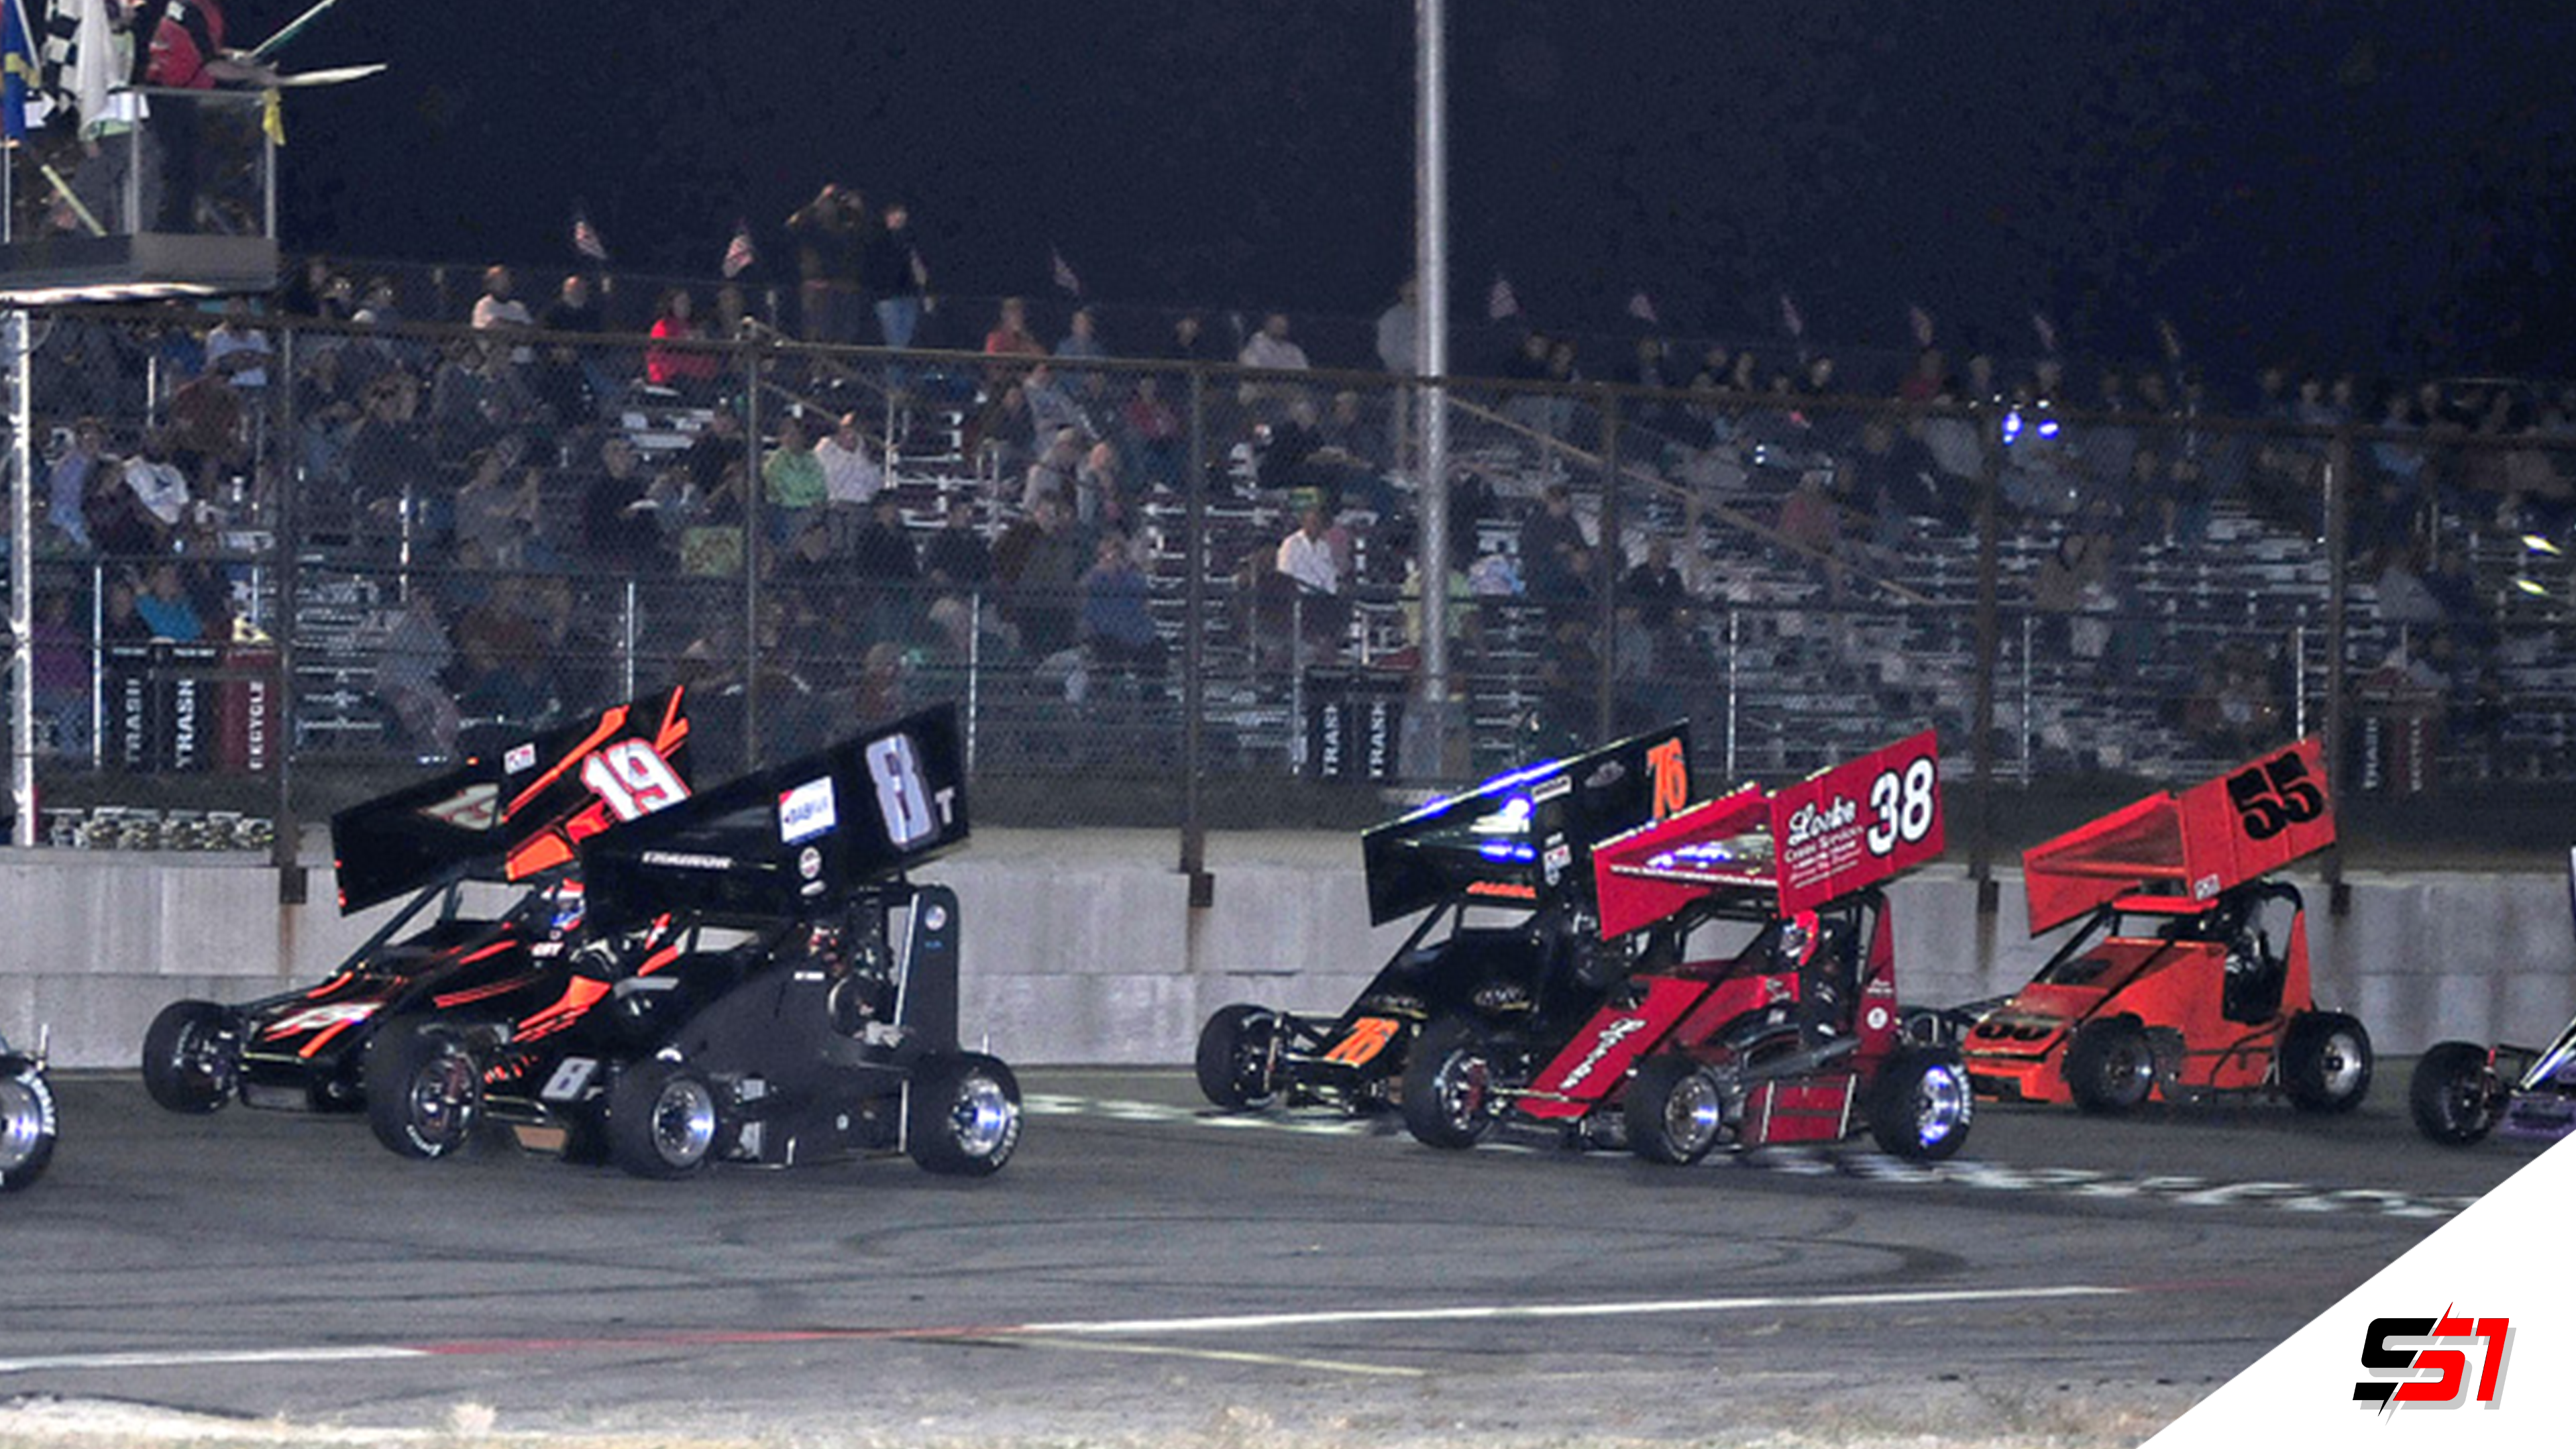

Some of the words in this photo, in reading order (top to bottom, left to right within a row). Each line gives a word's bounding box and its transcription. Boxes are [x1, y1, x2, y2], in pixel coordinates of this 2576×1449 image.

[176, 679, 195, 768] TRASH
[249, 681, 264, 769] RECYCLE
[1324, 704, 1340, 775] TRASH
[1370, 699, 1386, 777] TRASH
[580, 737, 692, 822] 19
[865, 733, 933, 849] 8
[1646, 737, 1688, 820] 76
[1867, 757, 1935, 856] 38
[2226, 750, 2324, 841] 55
[541, 1056, 597, 1099] 8
[1324, 1016, 1401, 1069] 76
